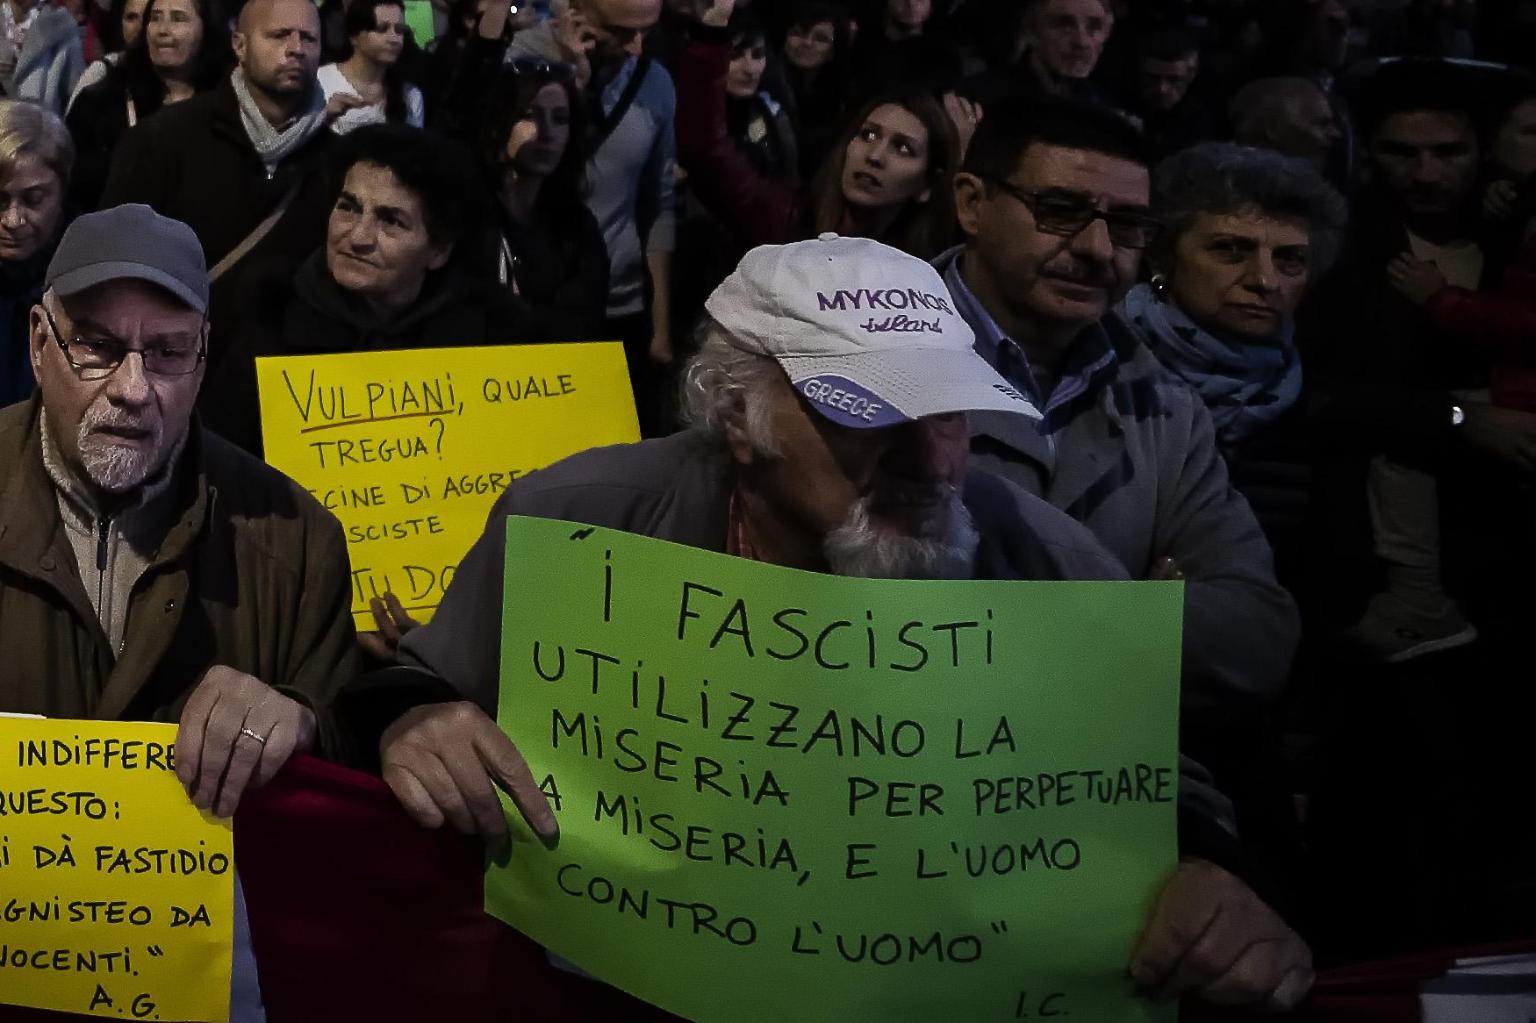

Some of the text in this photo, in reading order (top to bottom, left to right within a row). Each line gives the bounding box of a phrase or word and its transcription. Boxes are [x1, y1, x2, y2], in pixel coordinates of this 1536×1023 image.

[816, 288, 954, 316] MYKONOS
[282, 368, 577, 424] VULPIANI, QUALE
[802, 378, 883, 423] GREECE
[310, 418, 446, 469] TREGUA?
[309, 484, 386, 510] CINE
[400, 476, 431, 505] DI
[348, 515, 445, 544] SCISTE
[676, 581, 996, 673] FASCISTI
[533, 639, 1017, 760] UTILIZZANO LA
[551, 708, 1175, 819] MISERIA PER PERPETUARE
[34, 834, 77, 869] DÀ
[95, 840, 230, 876] FASTIDIO
[535, 773, 1083, 887] A MISERIA, E L'UOMO
[170, 904, 212, 929] DA
[557, 863, 758, 946] CONTRO
